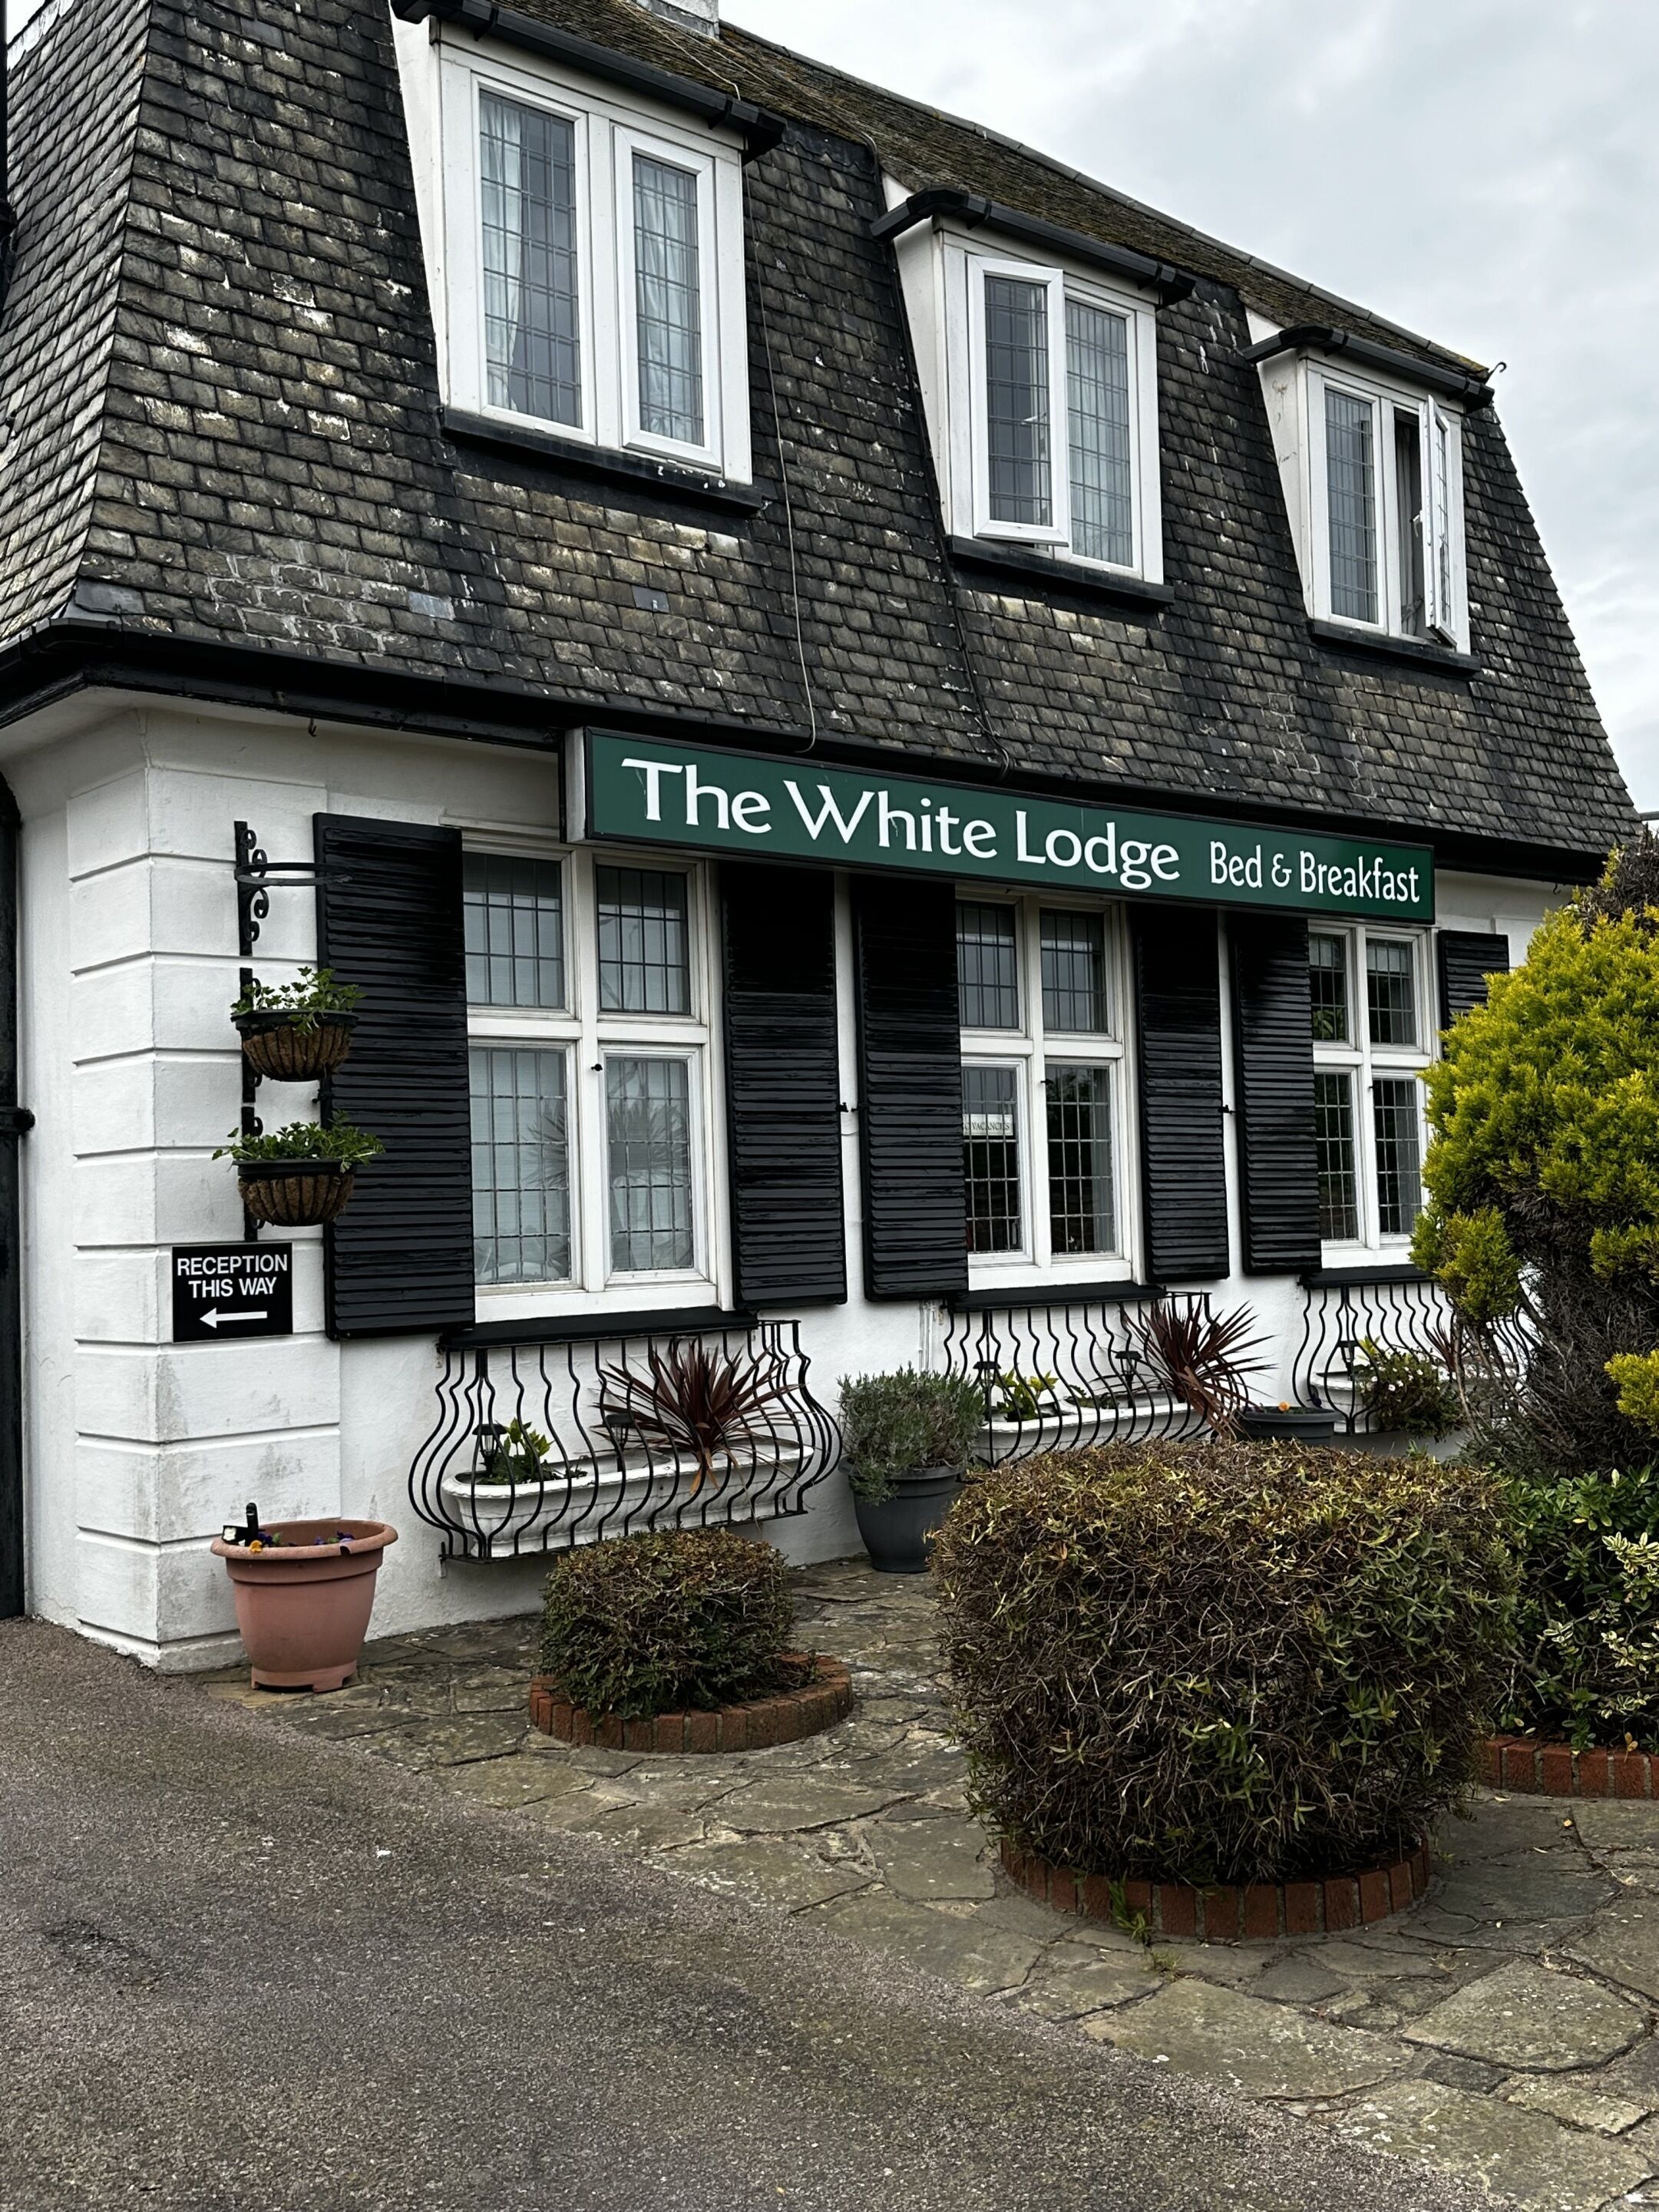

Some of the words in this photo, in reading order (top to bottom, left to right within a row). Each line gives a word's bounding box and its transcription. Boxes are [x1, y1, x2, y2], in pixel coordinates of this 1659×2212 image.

[621, 758, 772, 834] The
[783, 780, 998, 859] White
[1015, 810, 1181, 891] Lodge
[1210, 841, 1264, 888] Bed
[1271, 853, 1293, 888] &
[1300, 850, 1421, 903] Breakfast
[177, 1254, 288, 1276] RECEPTION
[188, 1278, 233, 1298] THIS
[238, 1276, 277, 1296] WAY
